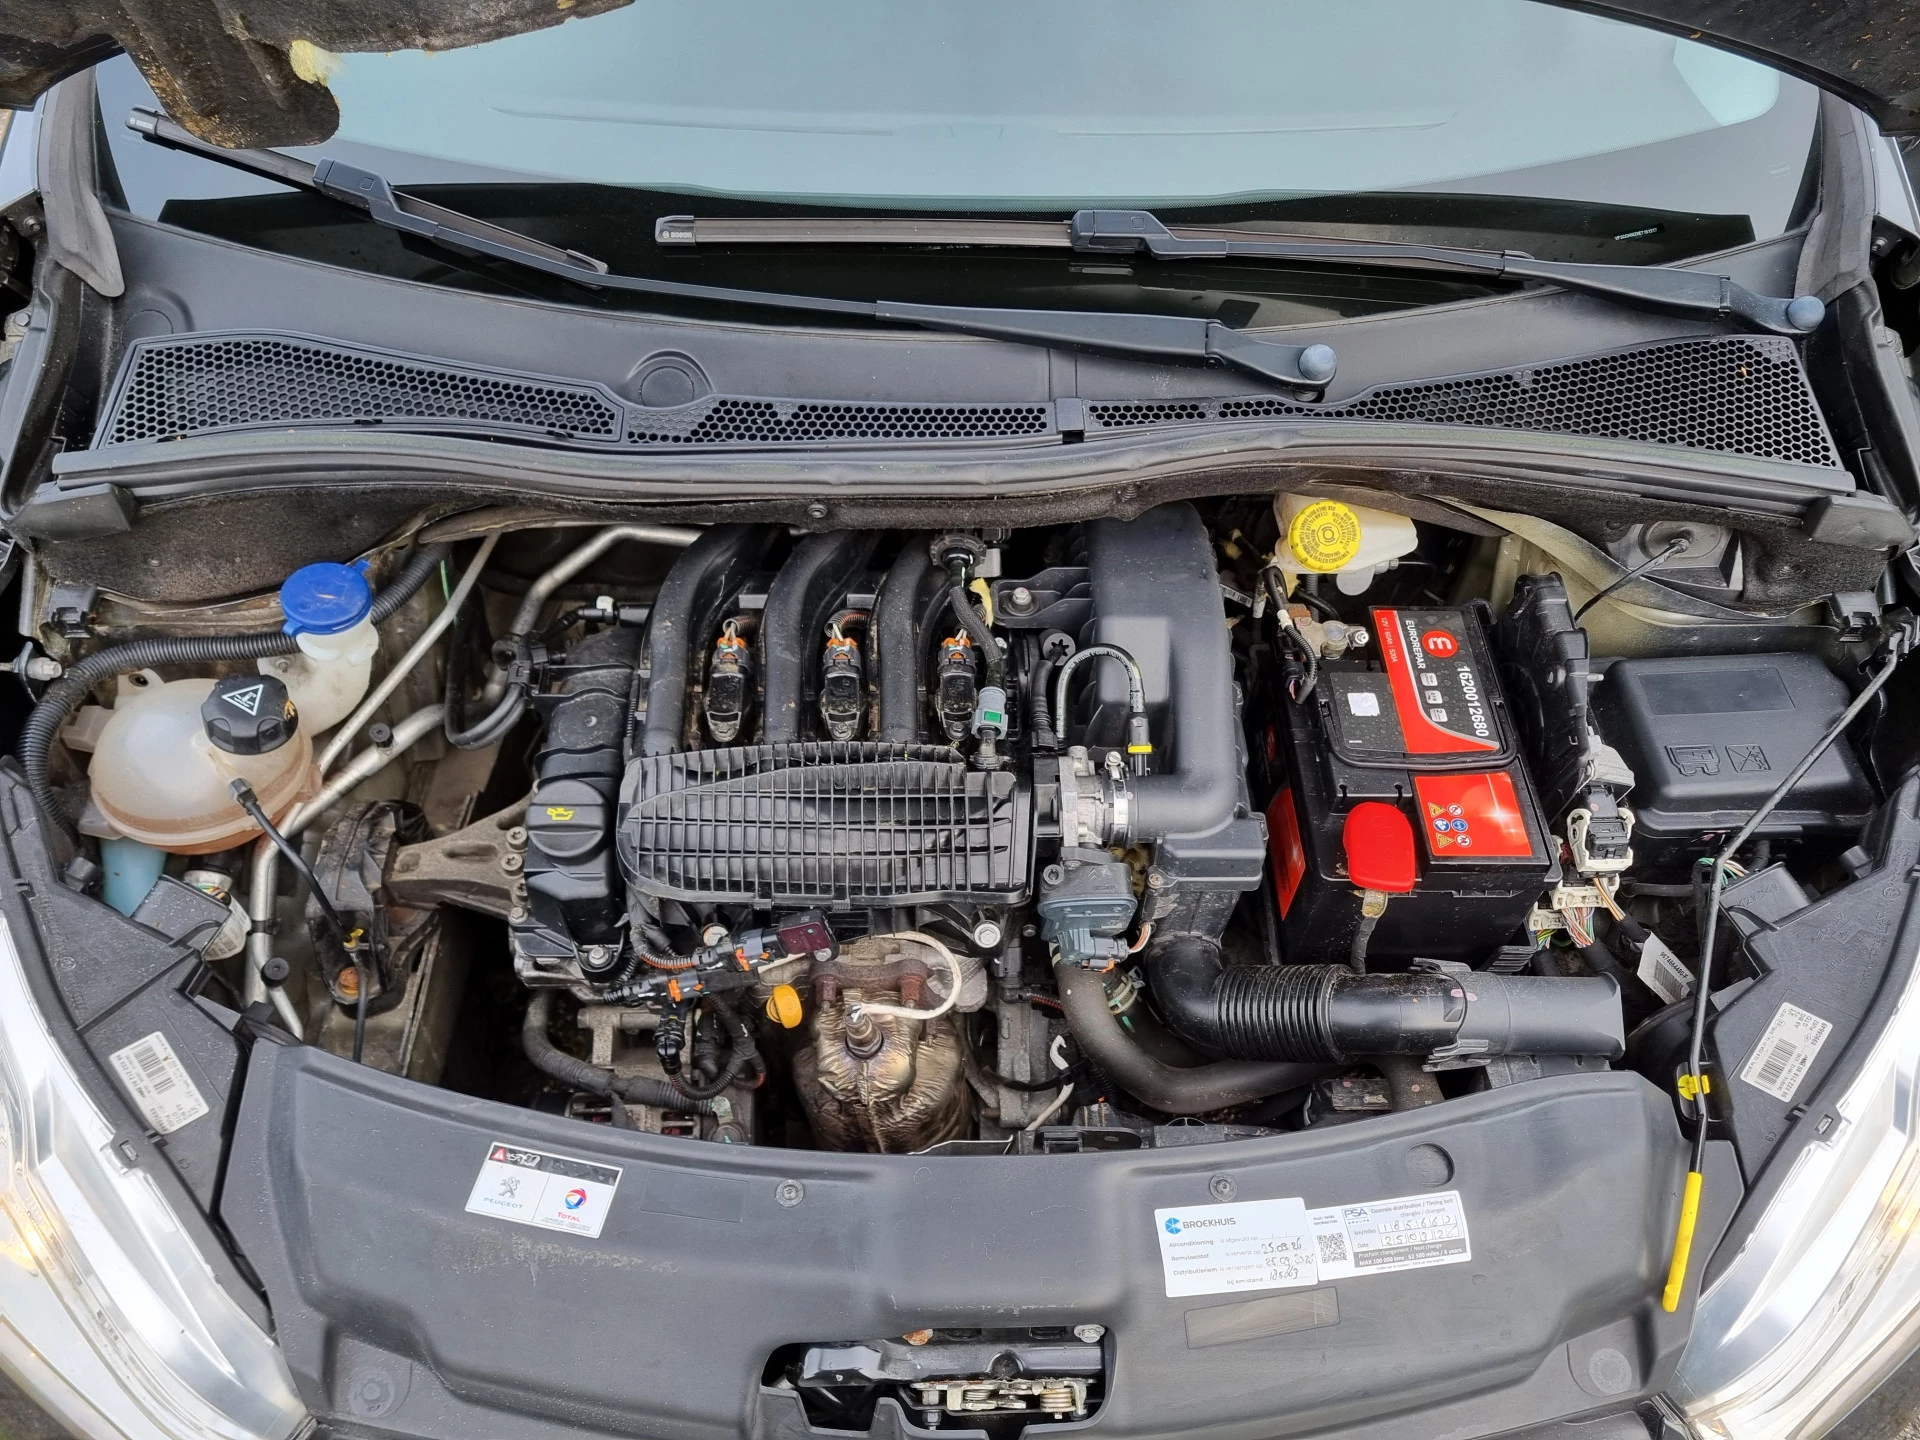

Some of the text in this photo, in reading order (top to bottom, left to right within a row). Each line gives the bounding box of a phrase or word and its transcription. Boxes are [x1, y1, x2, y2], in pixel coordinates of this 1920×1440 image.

[1405, 619, 1426, 669] EUROREPAR
[1457, 665, 1490, 737] 1620012680
[483, 1197, 524, 1209] PEUGEOT
[557, 1212, 580, 1222] TOTAL
[1344, 1208, 1368, 1218] PSA
[1183, 1217, 1236, 1229] BROEKHUIS
[1169, 1239, 1214, 1248] Airconditioning
